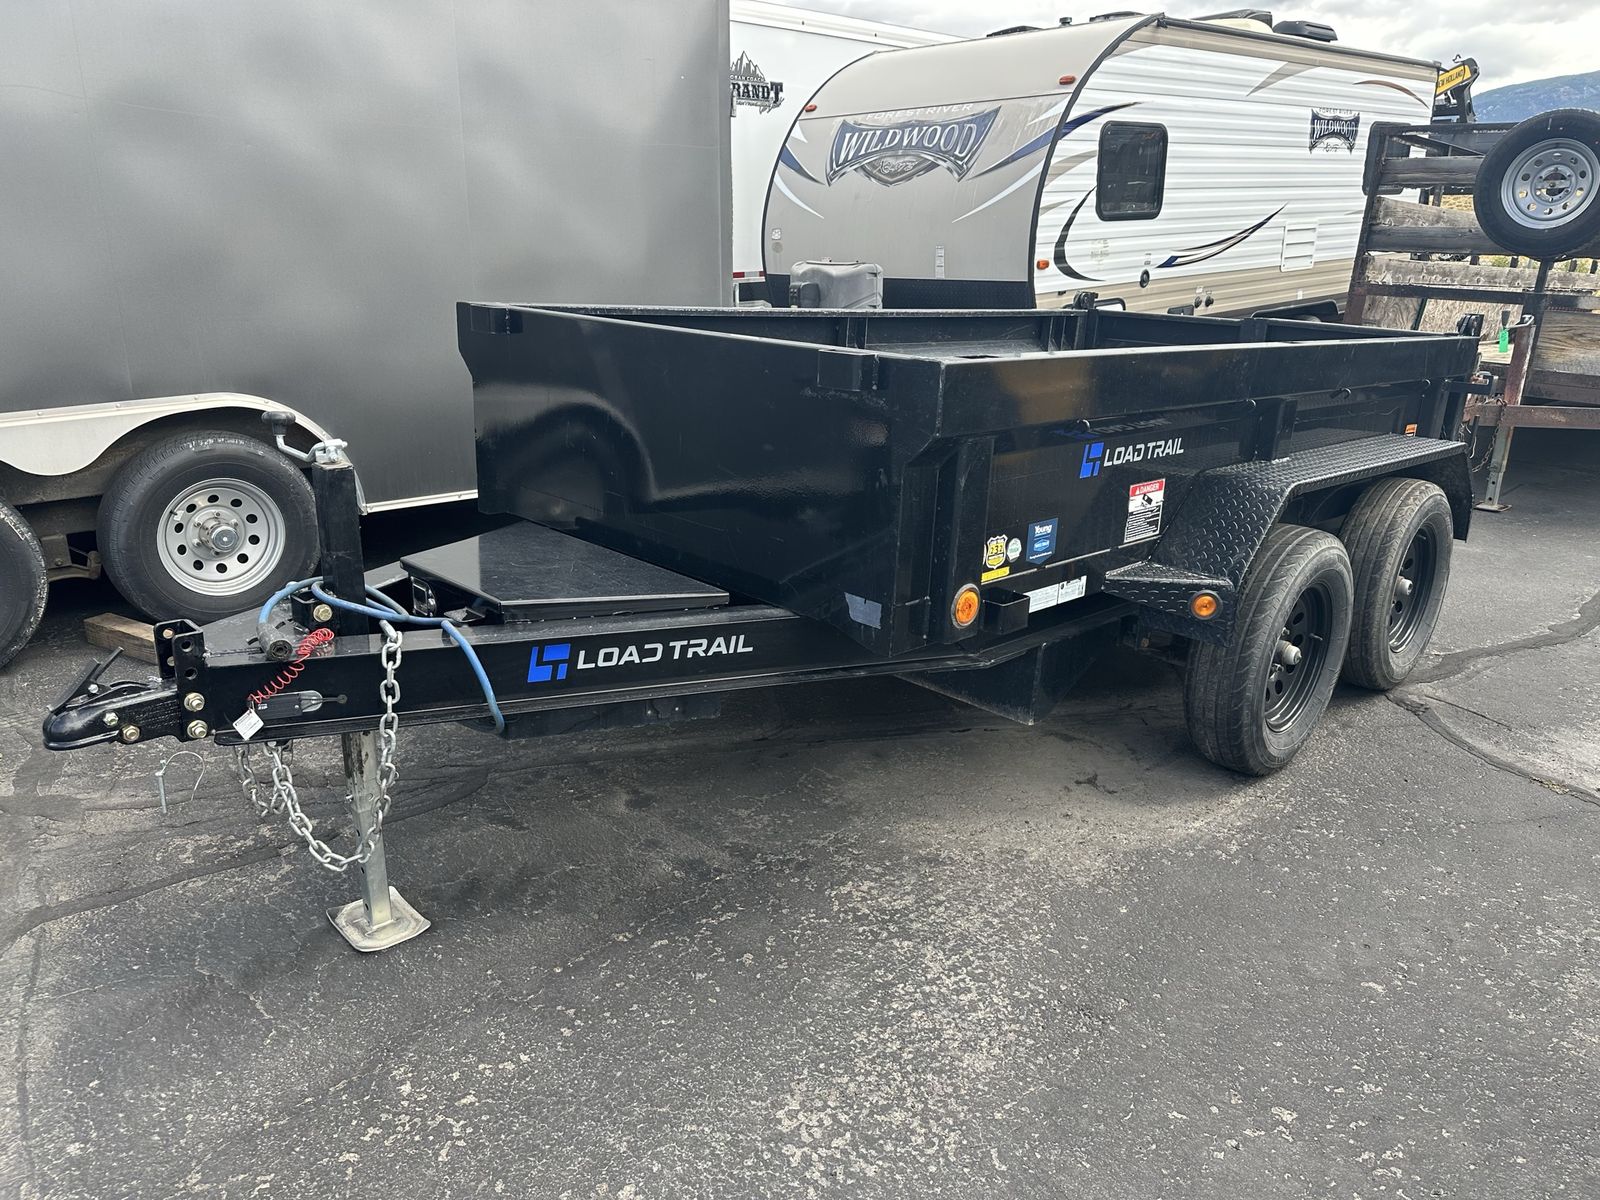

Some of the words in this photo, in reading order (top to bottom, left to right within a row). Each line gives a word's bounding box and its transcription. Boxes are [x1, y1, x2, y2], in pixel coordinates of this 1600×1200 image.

[1445, 69, 1465, 84] HOLLAND
[731, 81, 784, 104] RANDT
[866, 105, 925, 121] FOREST
[926, 103, 974, 115] RIVER
[1313, 119, 1356, 142] WILDWOOD
[838, 123, 978, 165] WILDWOOD
[1103, 443, 1146, 467] LOAD
[1147, 438, 1185, 459] TRAIL
[1140, 482, 1160, 494] DANGER
[1034, 525, 1053, 534] Young
[577, 643, 663, 670] LOAD
[669, 634, 753, 659] TRAIL
